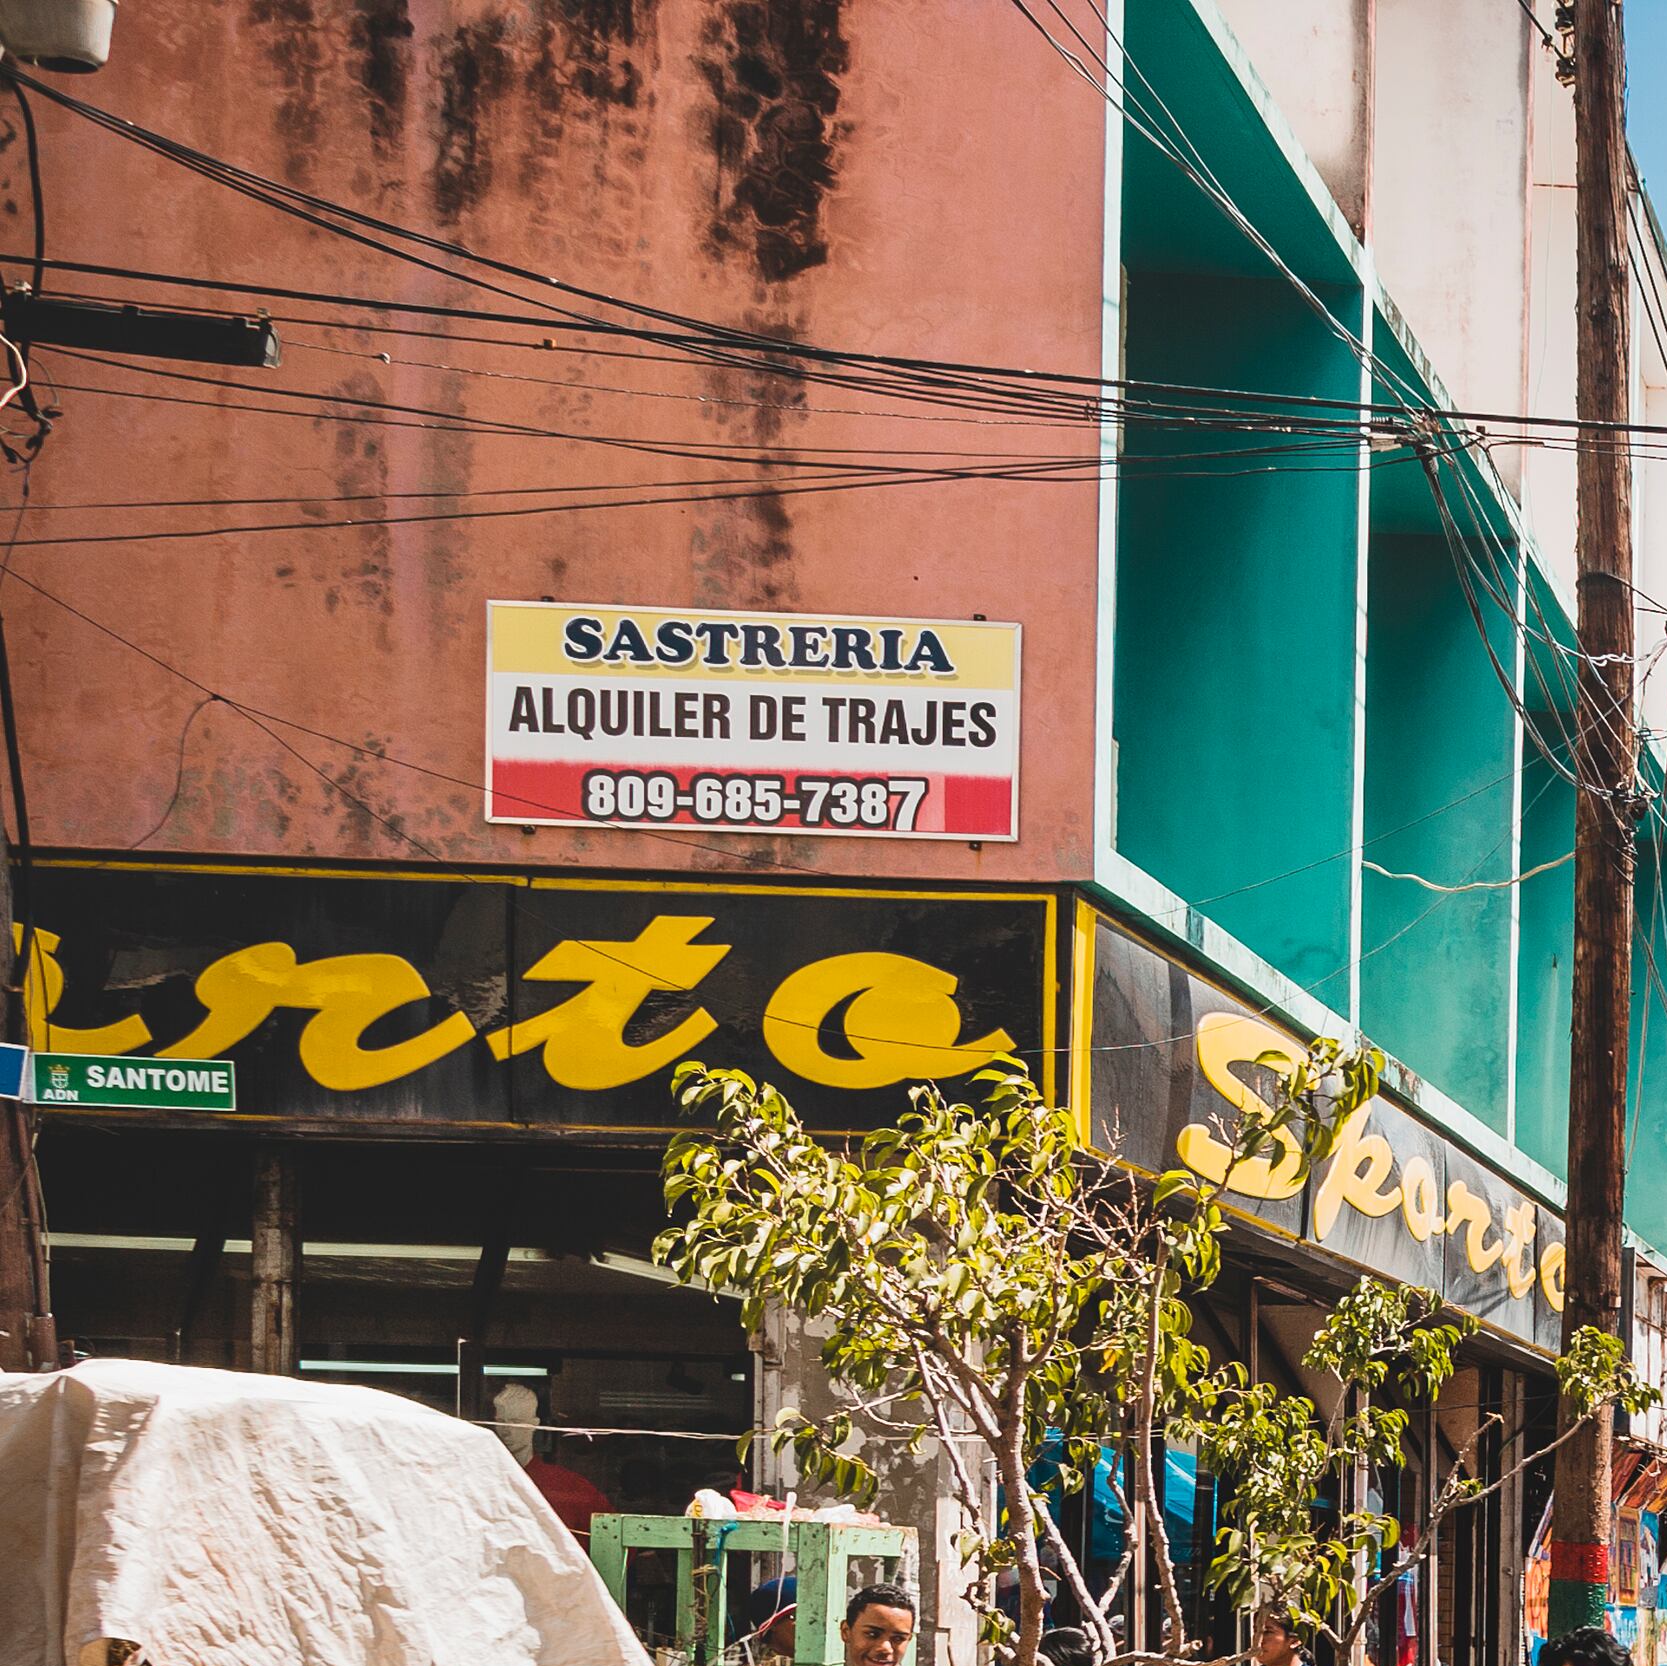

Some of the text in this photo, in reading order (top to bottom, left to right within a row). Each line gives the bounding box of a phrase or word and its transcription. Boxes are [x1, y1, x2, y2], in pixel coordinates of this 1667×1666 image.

[563, 616, 955, 674] SASTRERIA
[508, 686, 998, 748] ALQUILER DE TRAJES
[586, 773, 928, 831] 809-685-7387
[43, 1089, 79, 1101] ADN
[86, 1065, 230, 1094] SANTOME
